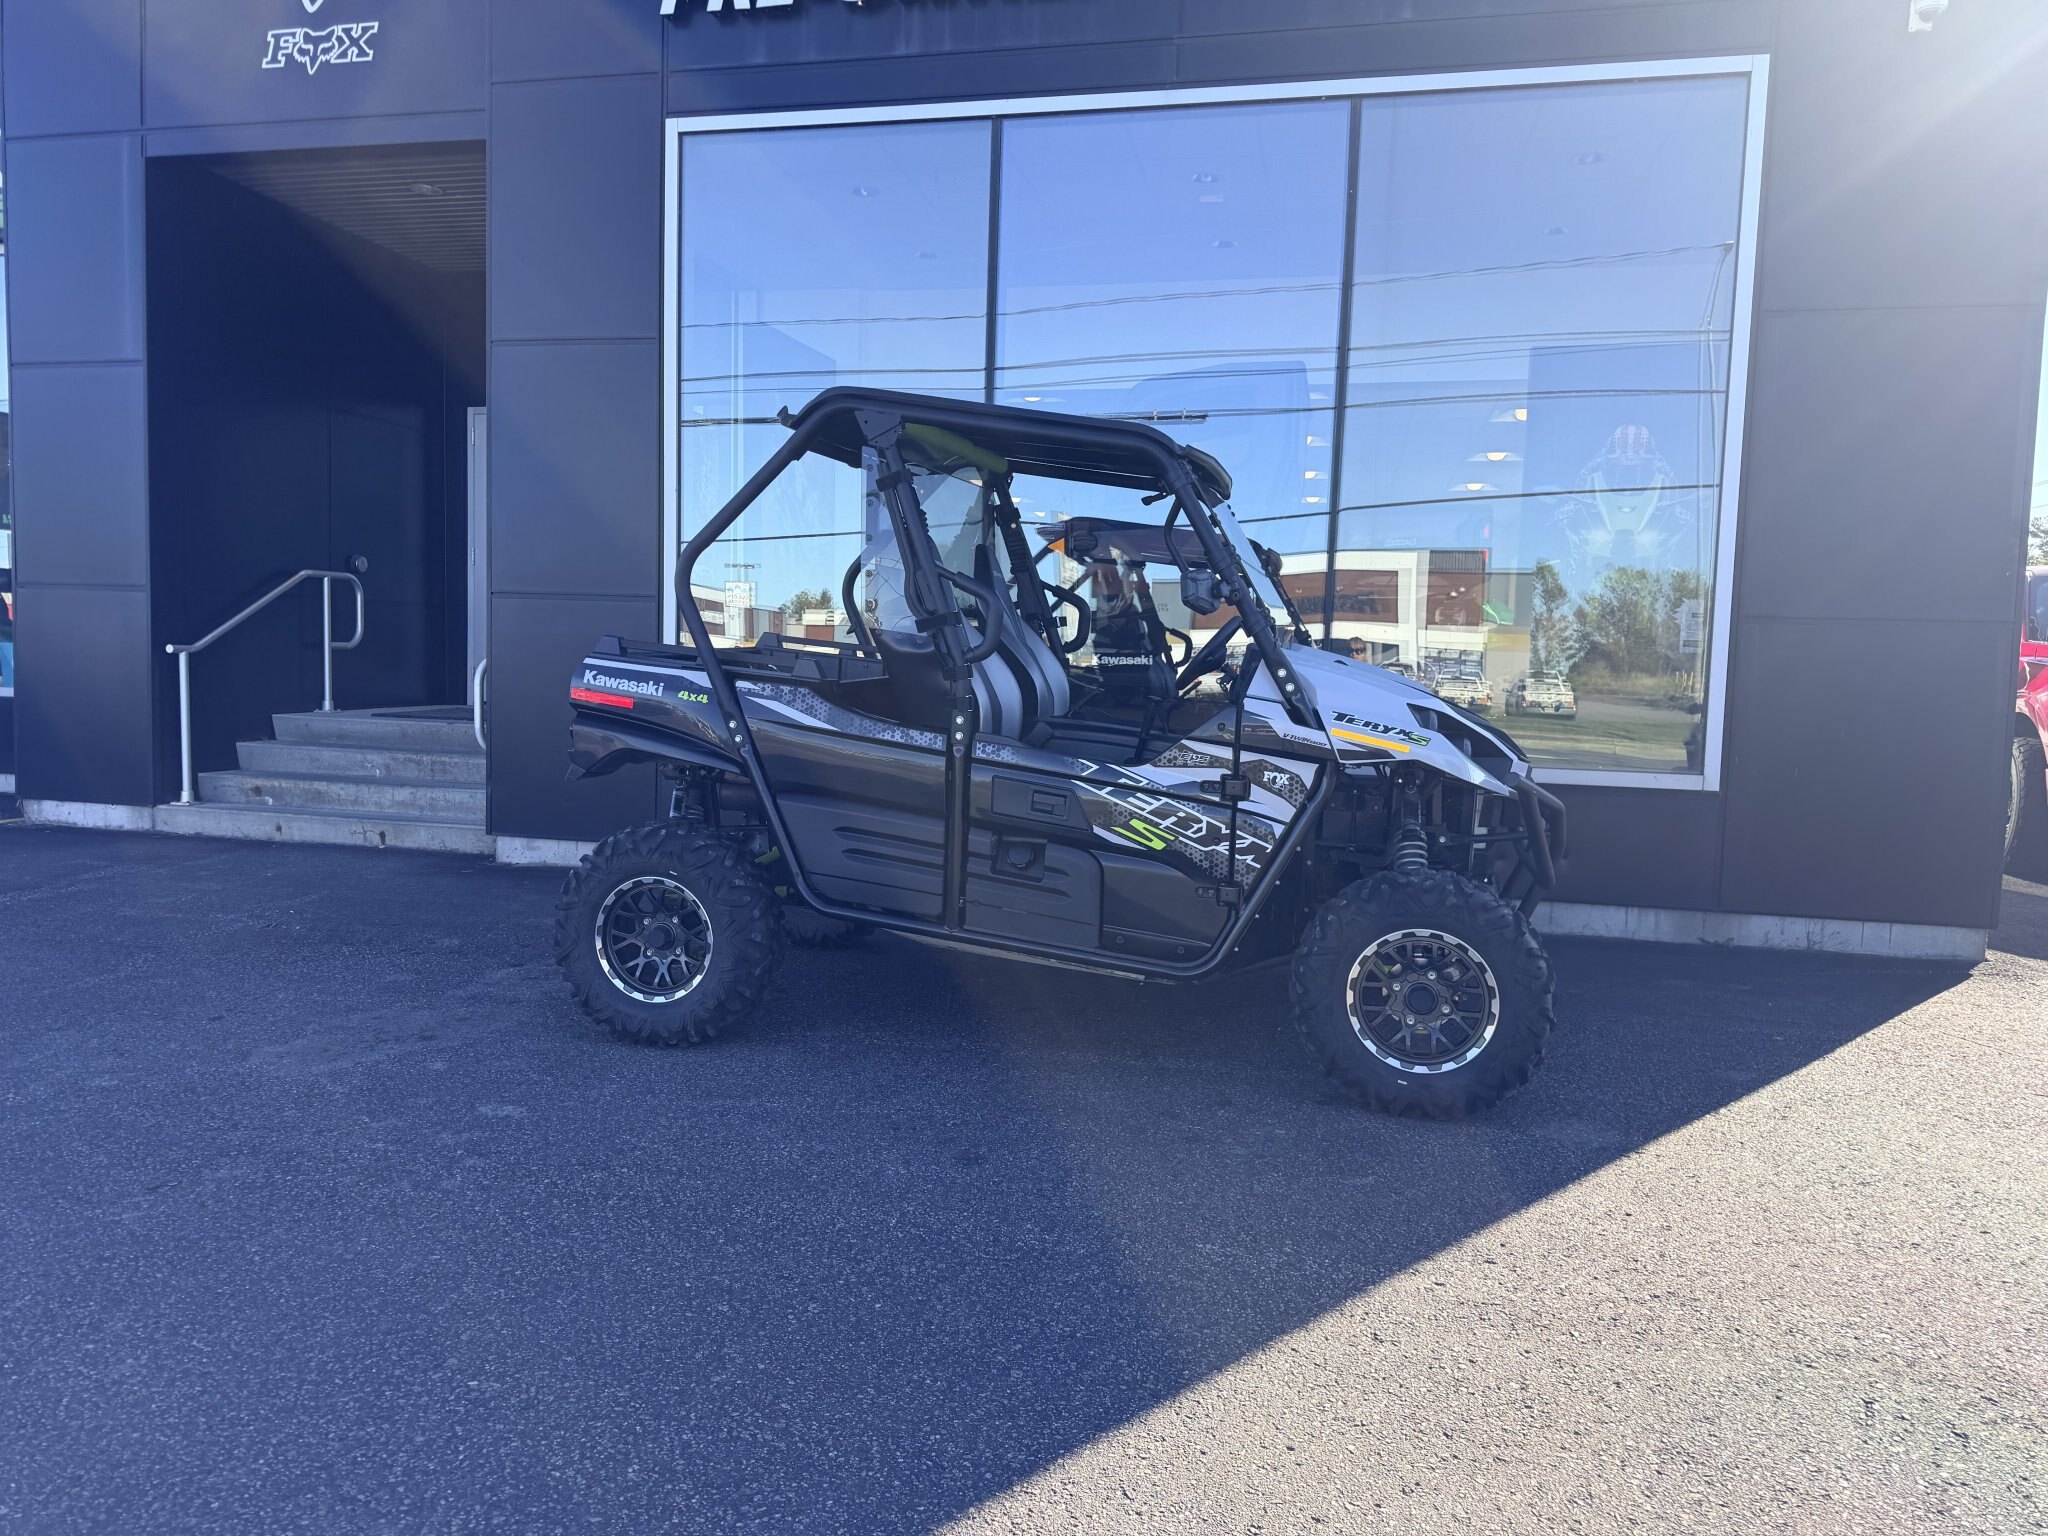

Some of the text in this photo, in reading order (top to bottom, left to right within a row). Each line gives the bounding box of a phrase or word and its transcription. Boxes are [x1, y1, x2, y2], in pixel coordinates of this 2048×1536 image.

[1092, 653, 1154, 666] Kawasaki
[583, 669, 664, 697] Kawasaki
[1263, 771, 1291, 790] FOX
